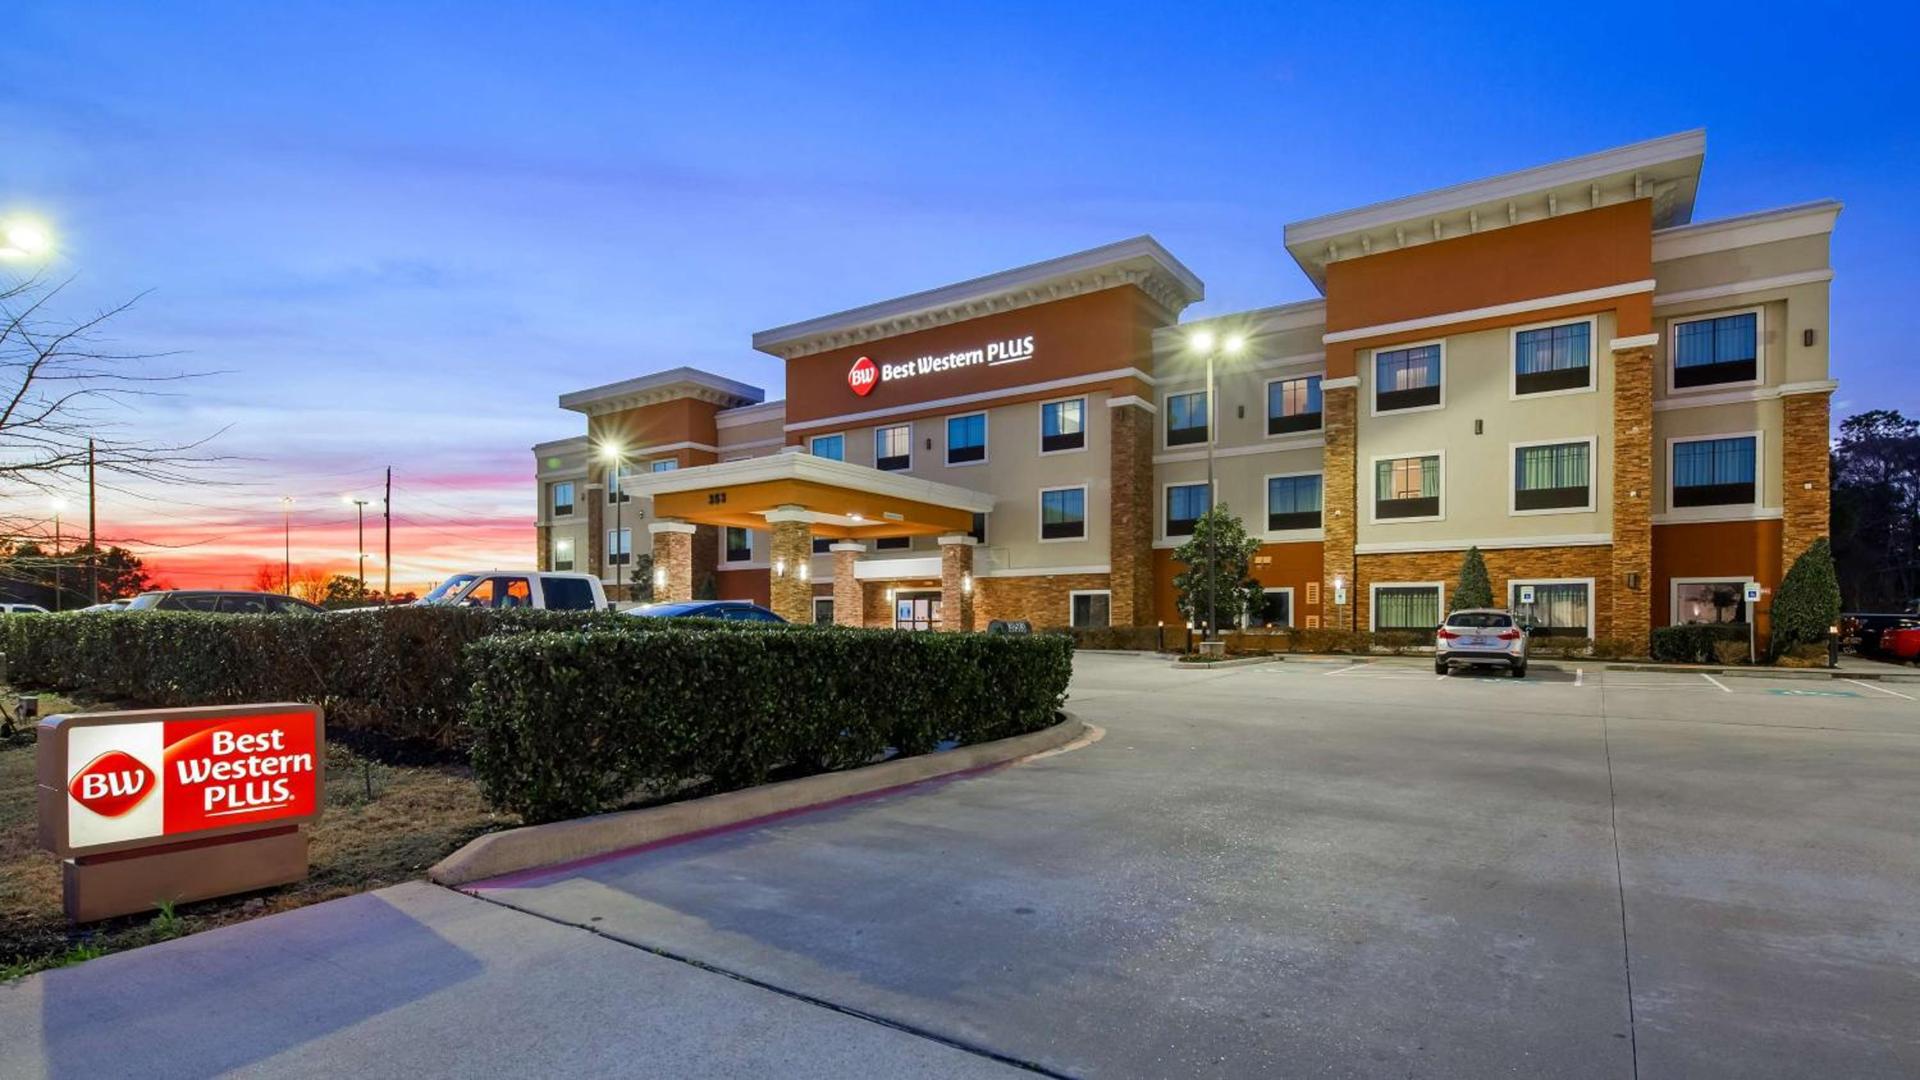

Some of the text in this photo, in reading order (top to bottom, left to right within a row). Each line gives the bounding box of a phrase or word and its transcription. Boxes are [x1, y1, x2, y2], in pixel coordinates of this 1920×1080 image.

[882, 336, 1034, 381] Best Western PLUS
[851, 368, 874, 386] BW
[212, 729, 284, 755] Best
[82, 769, 145, 800] BW
[176, 753, 312, 785] Western
[204, 778, 290, 811] PLUS
